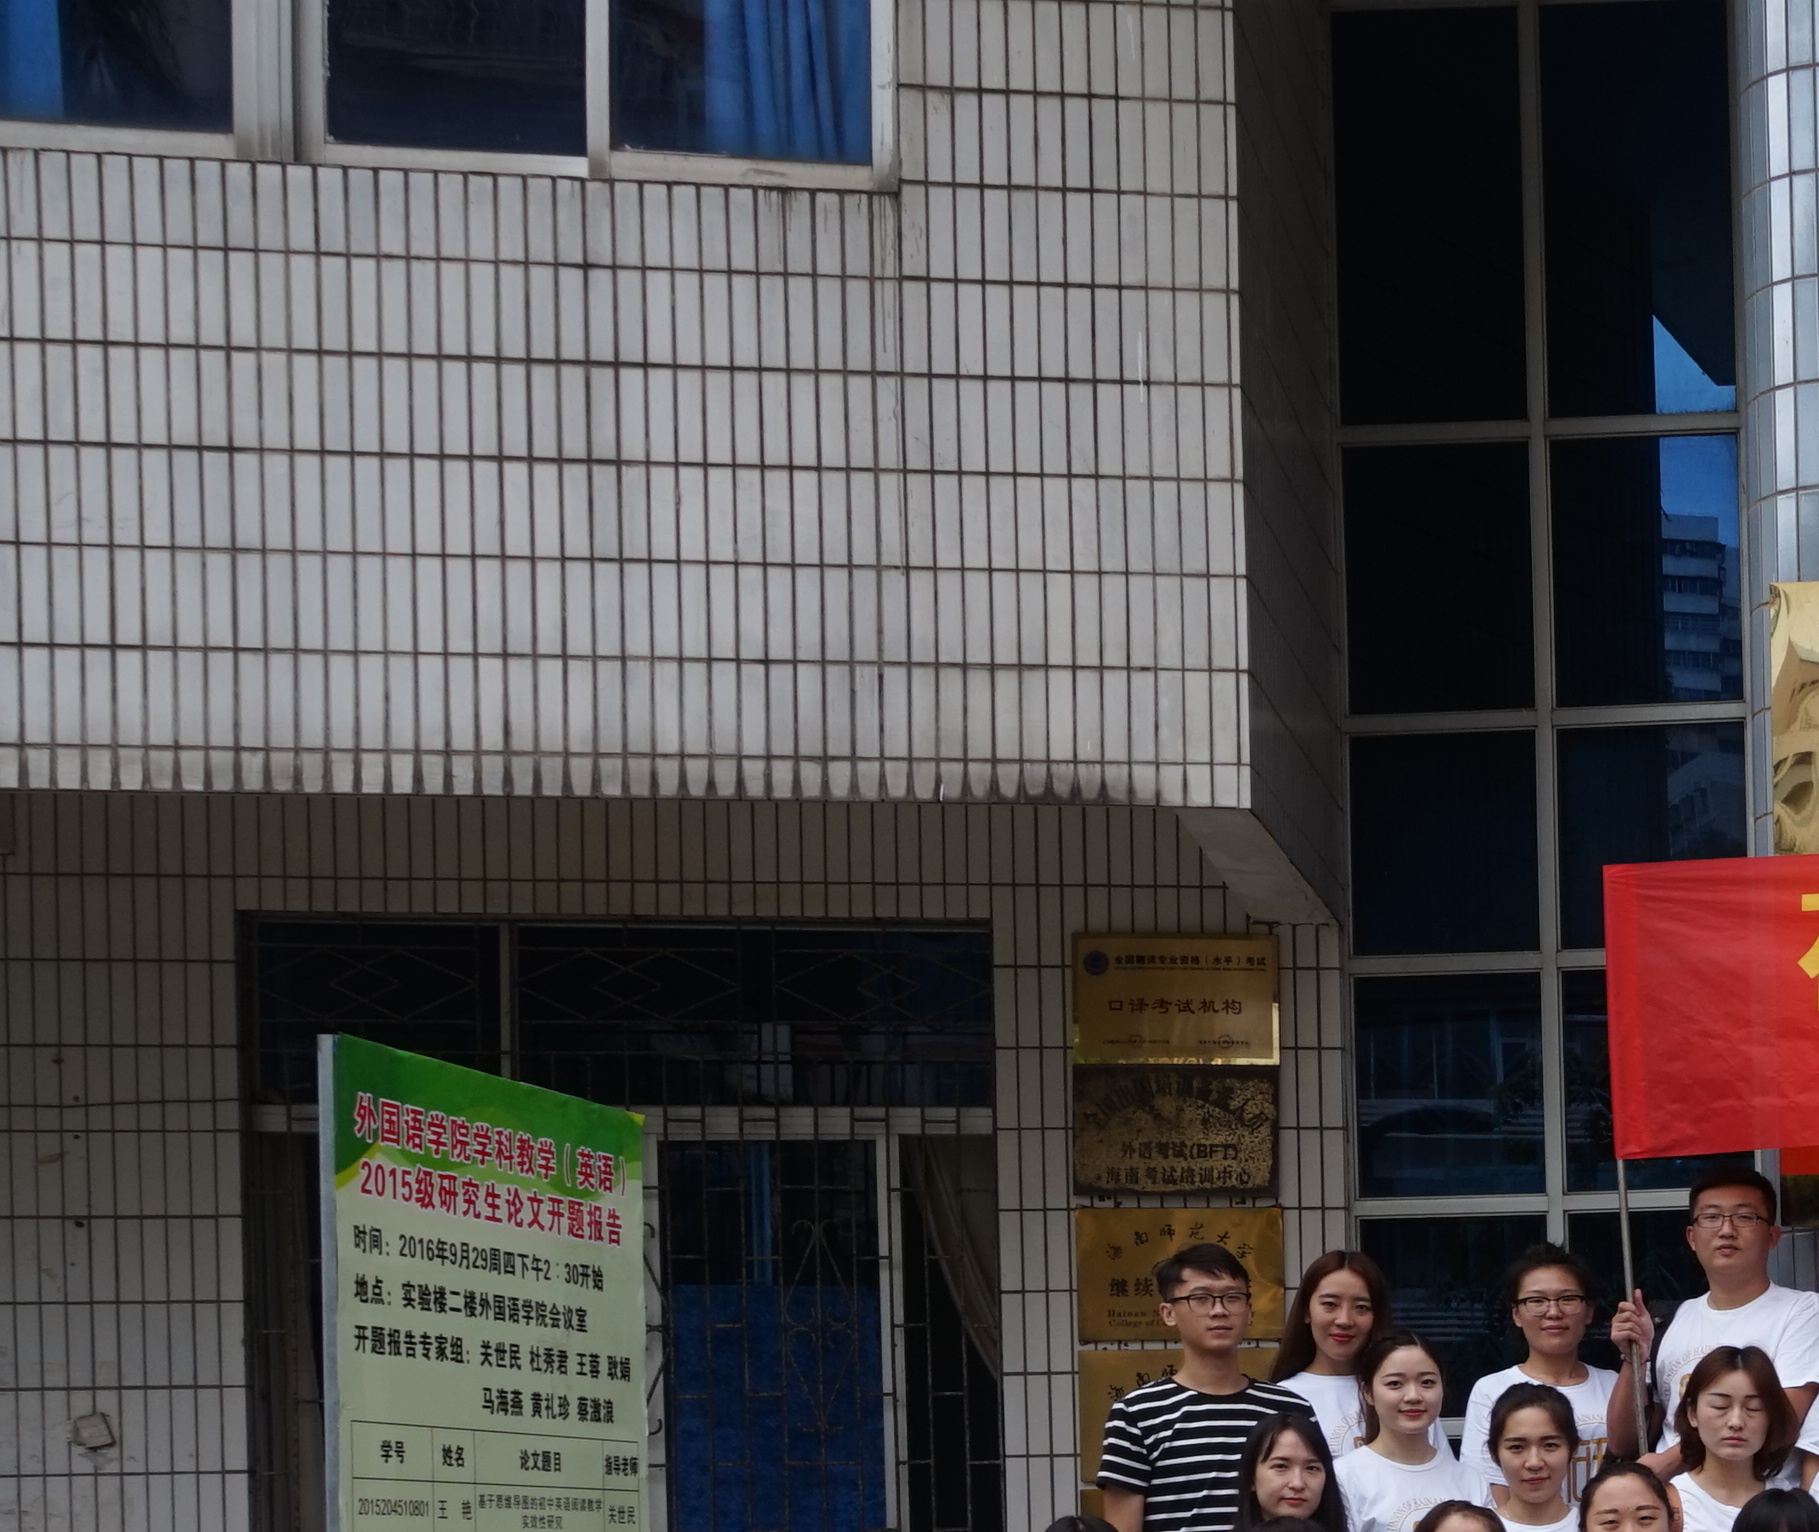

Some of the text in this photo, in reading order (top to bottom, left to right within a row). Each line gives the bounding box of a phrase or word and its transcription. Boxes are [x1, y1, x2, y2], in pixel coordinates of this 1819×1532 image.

[1108, 998, 1242, 1015] 口译考试机构
[360, 1160, 622, 1246] 2015级研究生论文开题报告
[481, 1387, 523, 1417] 马海燕
[531, 1392, 570, 1421] 黄礼珍
[379, 1439, 406, 1464] 学号
[442, 1445, 465, 1468] 姓名
[518, 1448, 561, 1473] 论文题目
[603, 1454, 636, 1477] 指导老师
